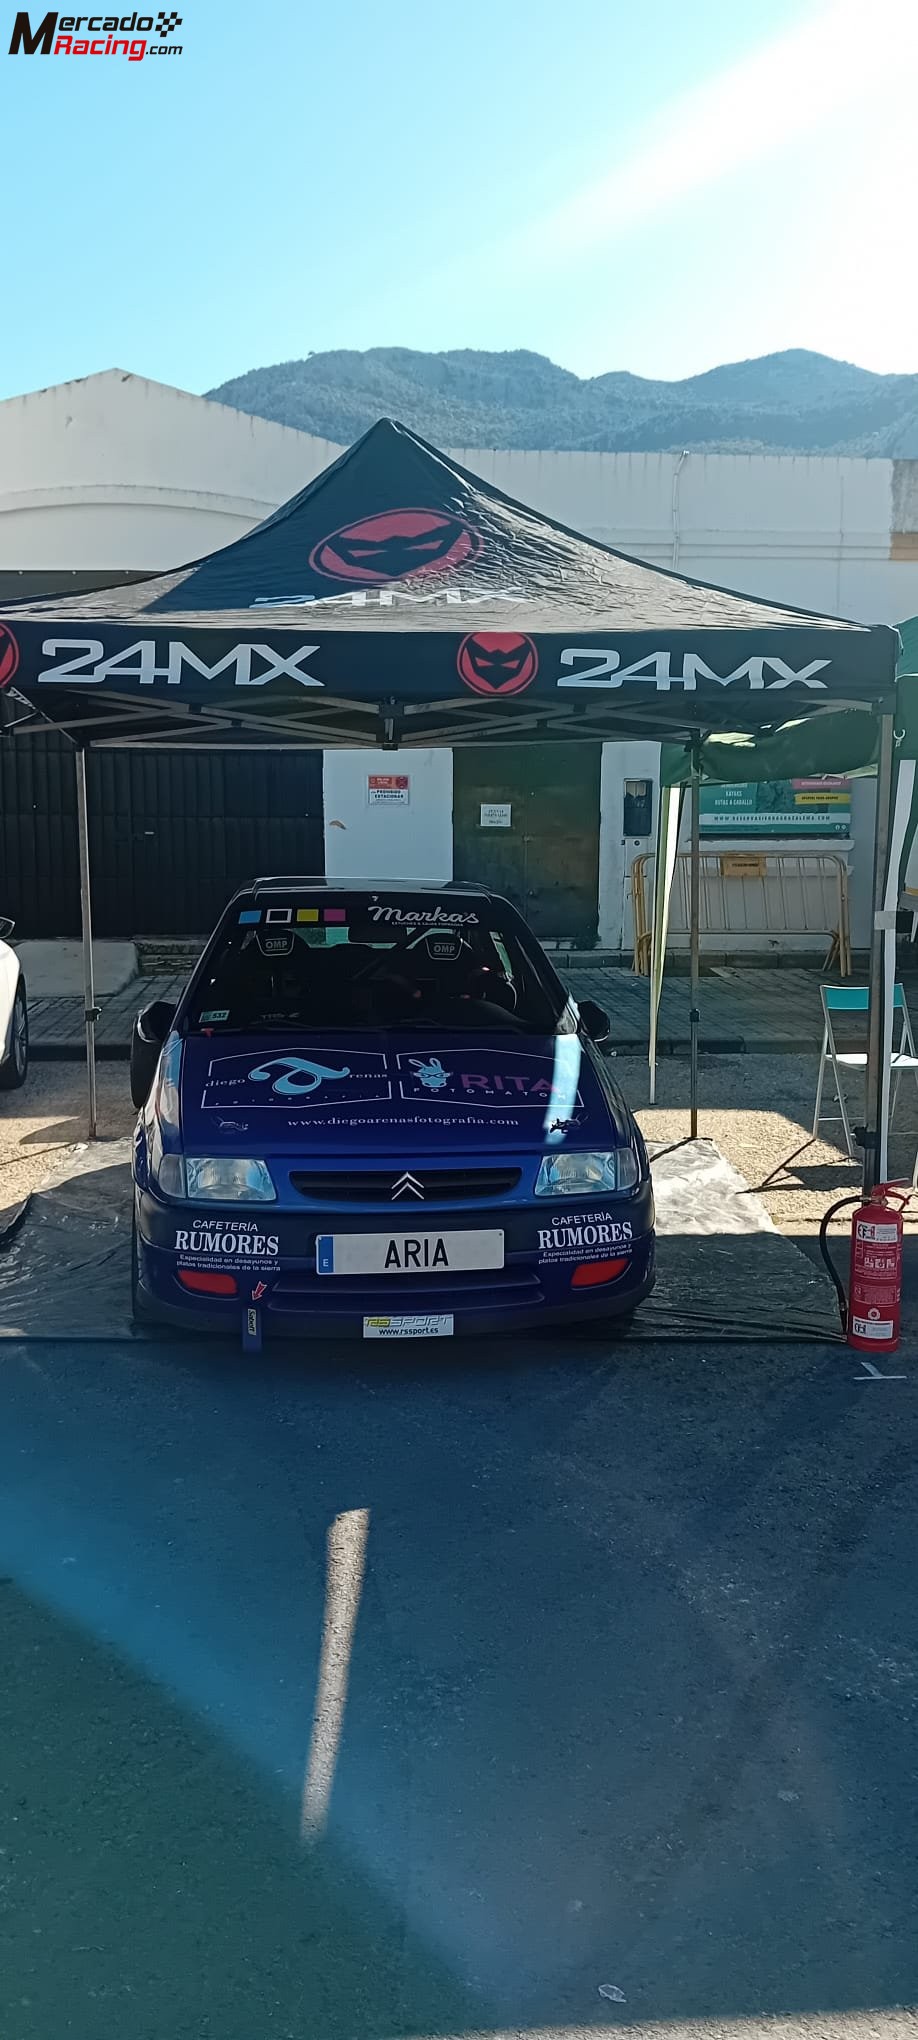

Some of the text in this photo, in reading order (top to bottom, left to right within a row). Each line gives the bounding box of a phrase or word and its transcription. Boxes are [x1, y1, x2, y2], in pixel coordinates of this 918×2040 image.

[38, 638, 325, 687] 24MX
[557, 648, 833, 691] 24MX
[265, 940, 288, 949] OMP
[433, 944, 456, 953] OMP
[205, 1078, 246, 1088] diego
[460, 1073, 560, 1093] RITA
[287, 1115, 519, 1128] www.diegoarenasfotografia.com
[192, 1219, 258, 1232] CAFETERÍA
[537, 1221, 633, 1249] RUMORES
[174, 1230, 279, 1256] RUMORES
[322, 1238, 449, 1269] E ARIA
